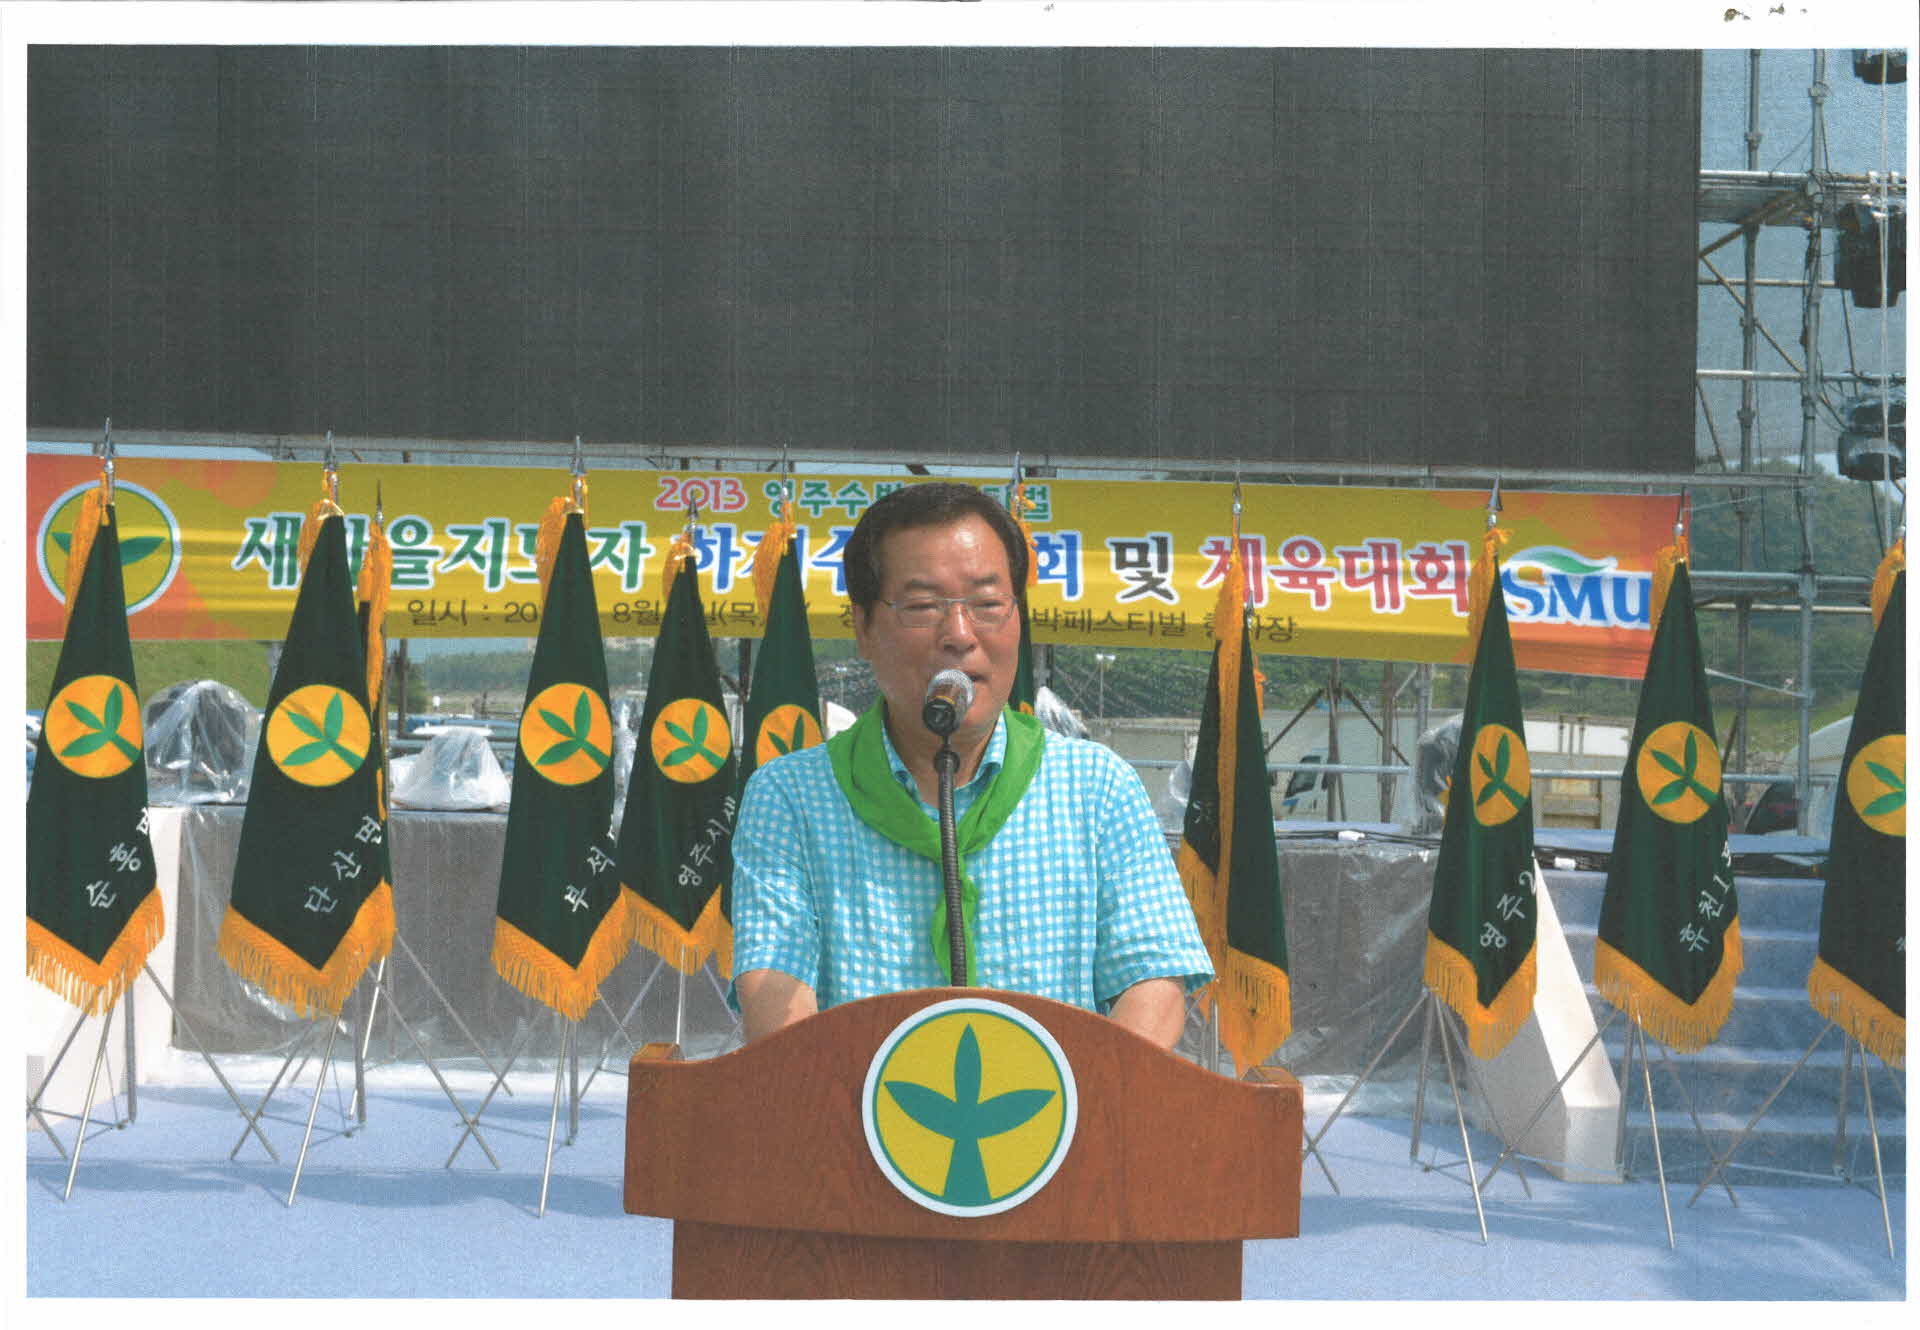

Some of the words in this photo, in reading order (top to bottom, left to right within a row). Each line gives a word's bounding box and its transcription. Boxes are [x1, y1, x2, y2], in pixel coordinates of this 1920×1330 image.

[655, 477, 746, 511] 2013
[1108, 532, 1178, 604] 및
[1198, 535, 1470, 615] 체육대회
[408, 600, 467, 626] 일시
[613, 602, 660, 627] 8월
[1500, 567, 1651, 629] SMU
